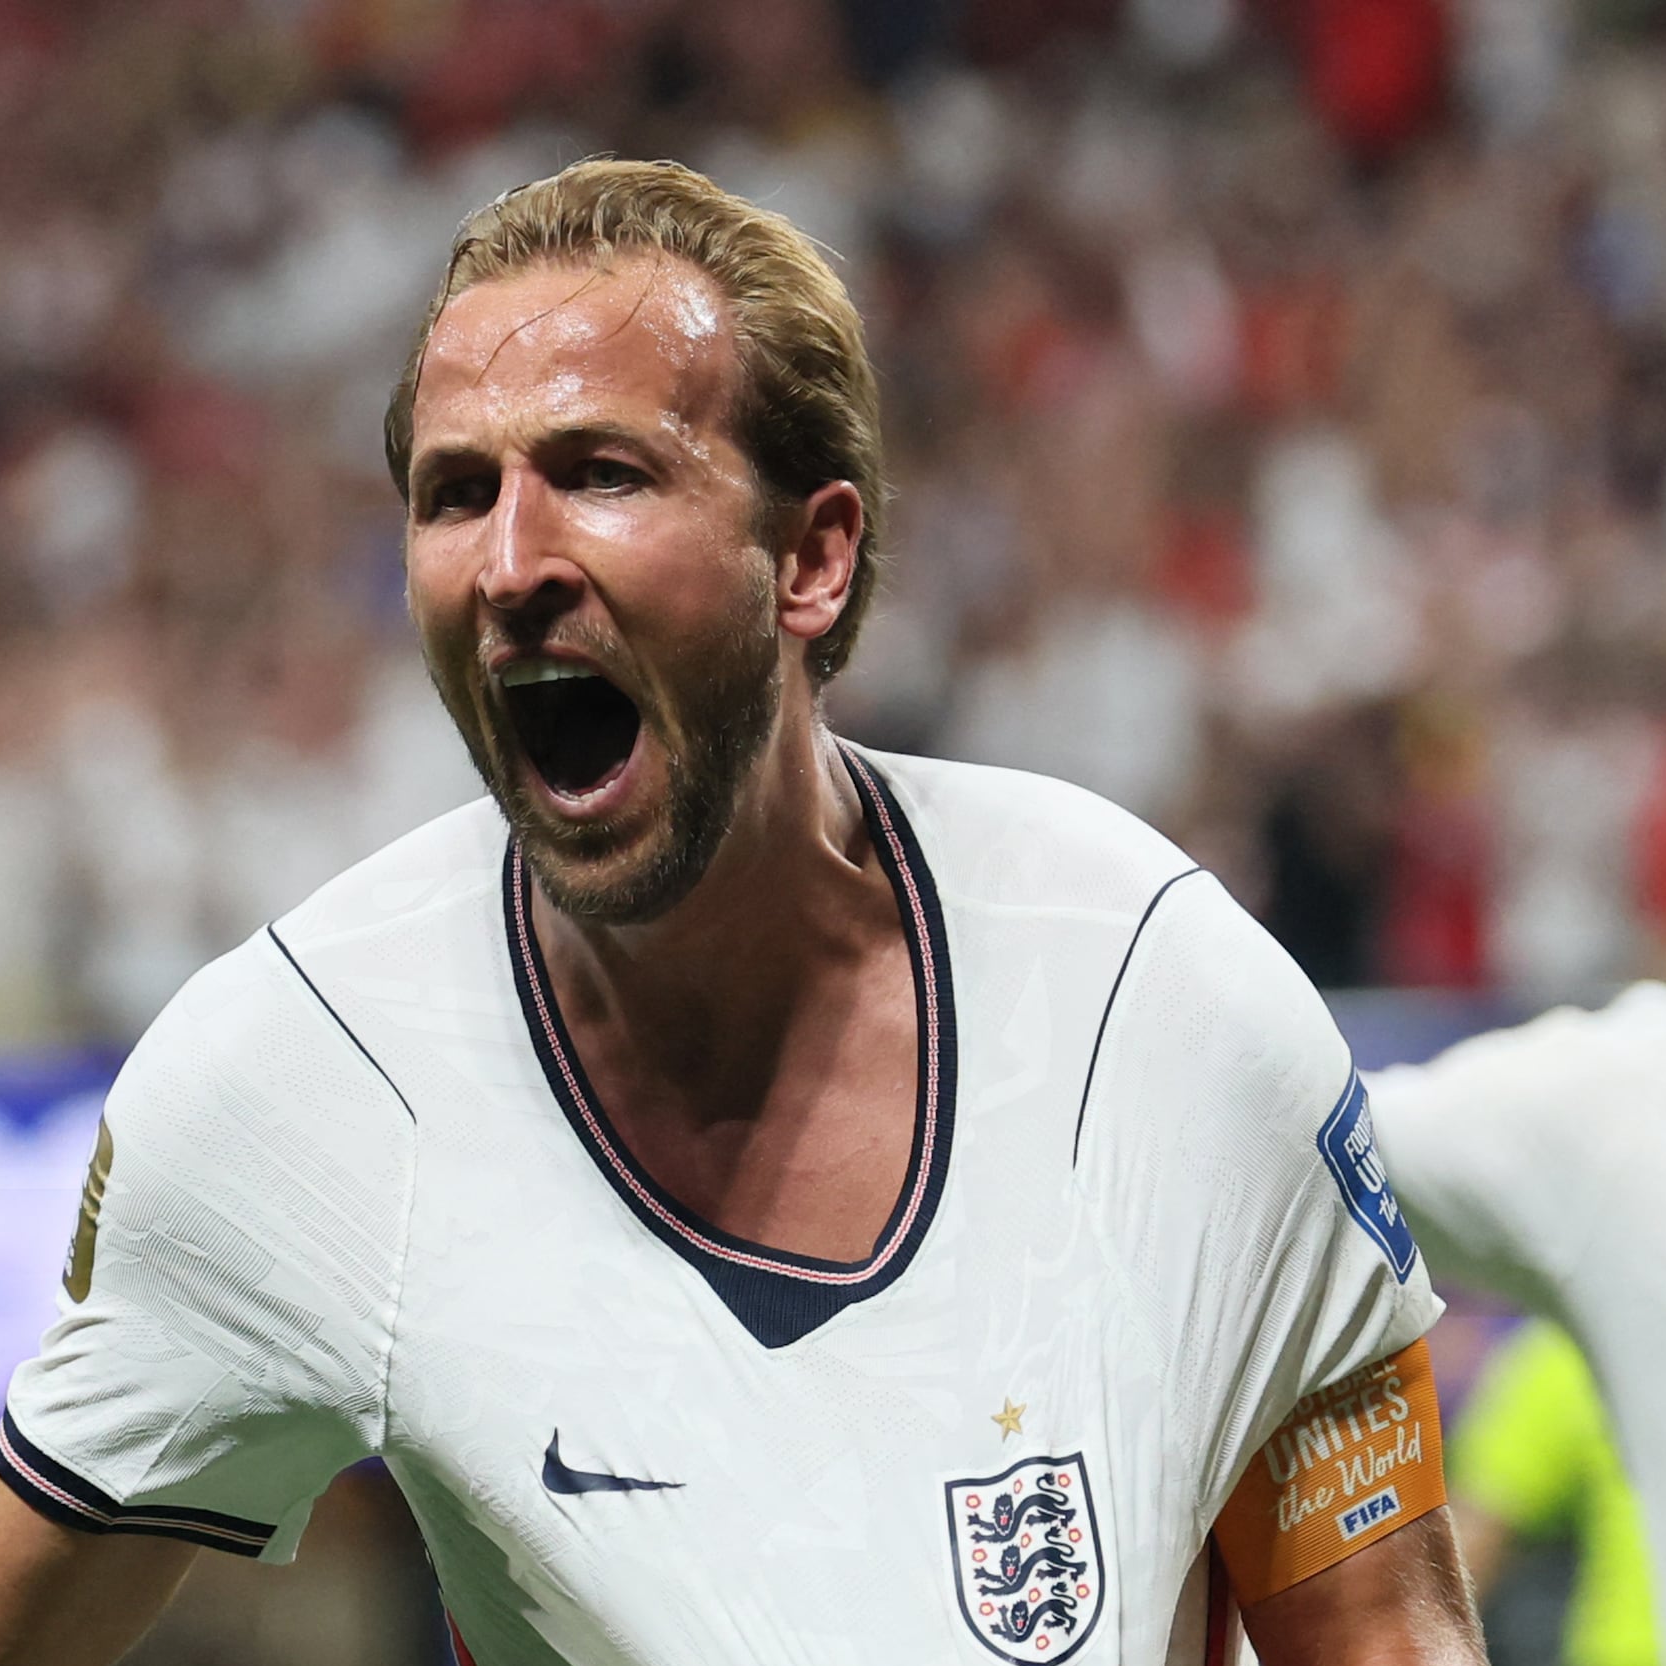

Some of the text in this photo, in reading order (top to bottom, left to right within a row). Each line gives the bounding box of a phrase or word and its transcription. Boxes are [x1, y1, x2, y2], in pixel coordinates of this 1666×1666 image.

[1264, 1376, 1409, 1485] UNITES
[1275, 1421, 1422, 1532] the World
[1343, 1494, 1396, 1535] FIFA
